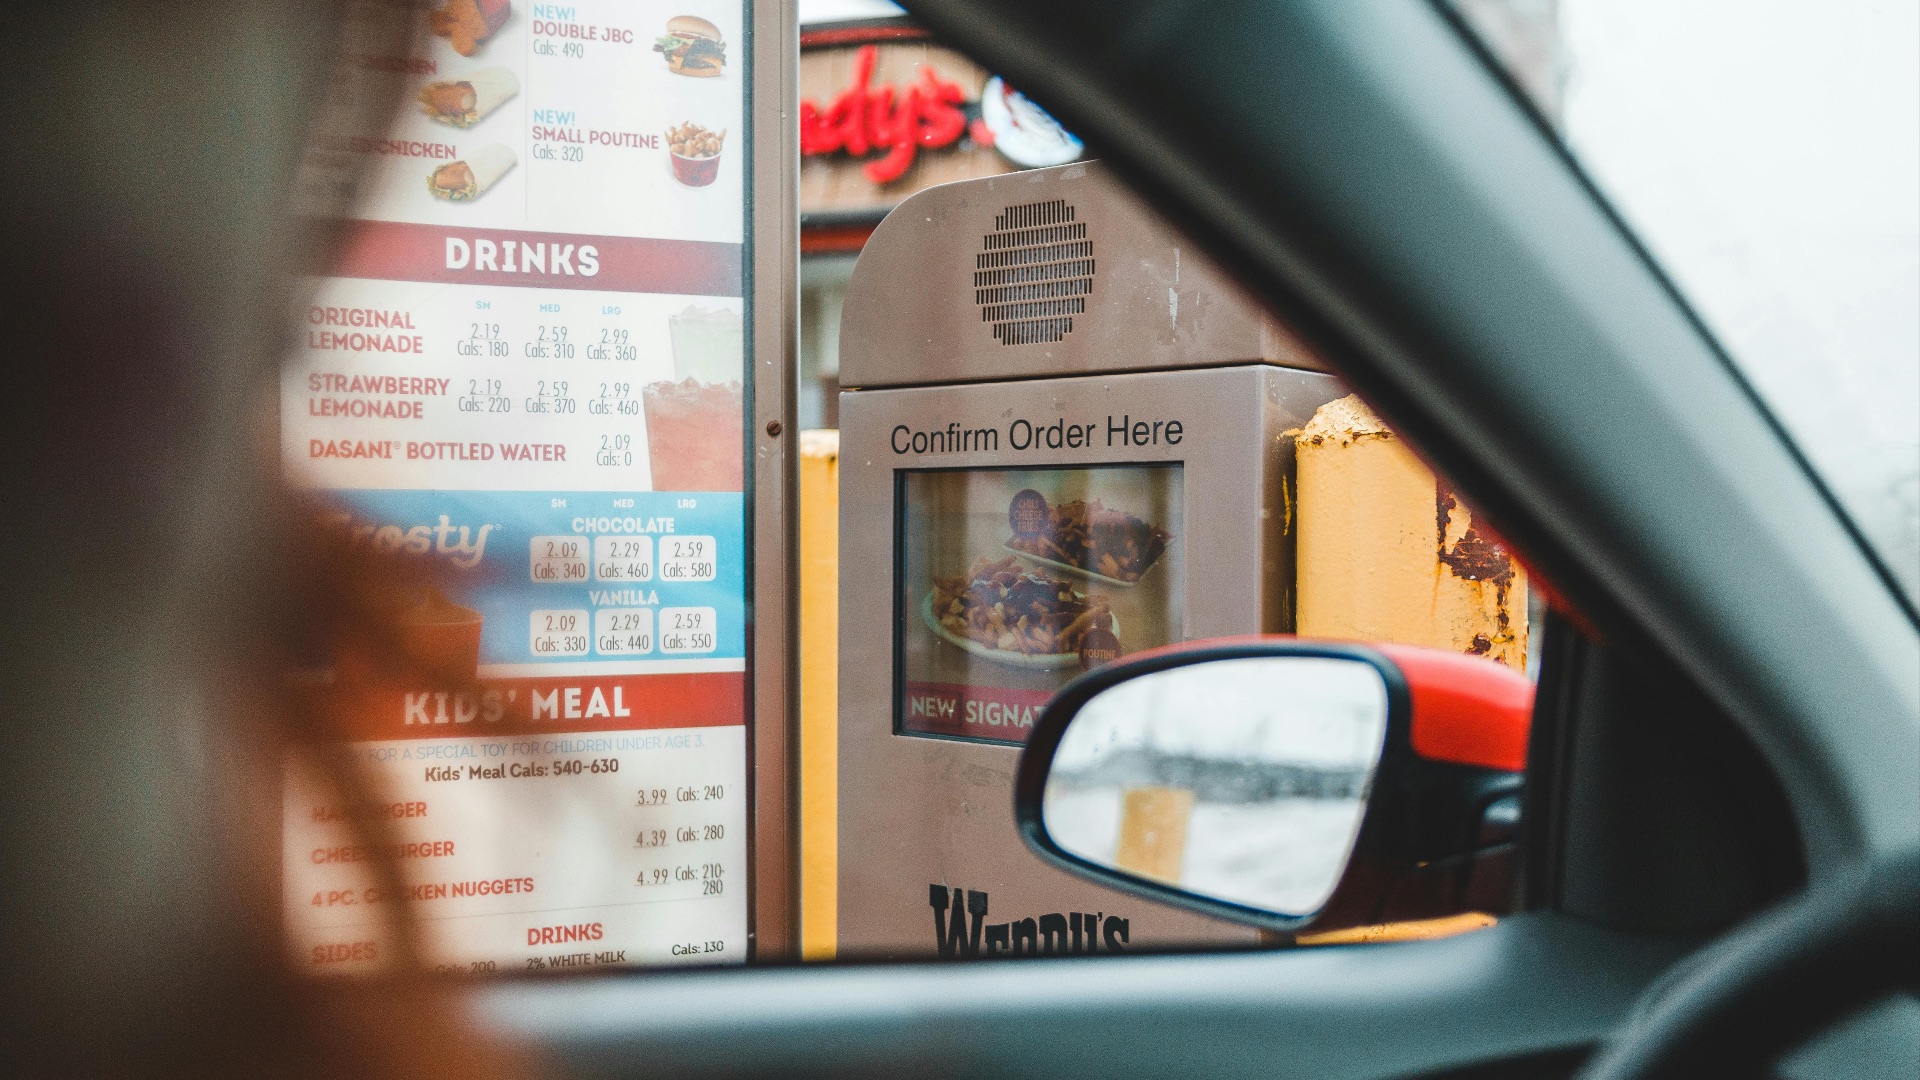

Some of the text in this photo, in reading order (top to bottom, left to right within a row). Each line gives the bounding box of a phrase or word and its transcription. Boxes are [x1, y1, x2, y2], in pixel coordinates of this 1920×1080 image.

[534, 4, 576, 21] NEW!
[533, 20, 633, 44] DOUBLE JBC
[533, 39, 584, 58] Cals: 490
[533, 109, 576, 126] NEW!
[532, 126, 660, 150] SMALL POUTINE
[533, 143, 584, 162] Cals: 320
[446, 237, 600, 277] DRINKS
[308, 305, 416, 330] ORIGINAL
[475, 301, 622, 316] SM MED LRG
[308, 331, 423, 355] LEMONADE
[471, 323, 629, 345] 2.19 2.59 2.99
[456, 339, 637, 362] Cals: 180 Cals: 310 Cals: 360
[308, 372, 450, 397] STRAWBERRY
[469, 379, 630, 399] 2.19 2.59 2.99
[308, 398, 423, 420] LEMONADE
[458, 397, 639, 417] Cals: 220 Cals: 370 Cals: 460
[601, 434, 631, 451] 2.09
[891, 415, 1184, 455] Confirm Order Here
[406, 442, 495, 462] BOTTLED
[499, 443, 567, 463] WATER
[596, 450, 632, 467] Cals: 0
[551, 498, 697, 510] SM MED LRG
[572, 517, 675, 534] CHOCOLATE
[546, 541, 704, 558] 2.09 2.29 2.59
[534, 561, 712, 580] Cals: 340 Cals: 460 Cals: 580
[589, 590, 660, 606] VANILLA
[545, 613, 702, 632] 2.09 2.29 2.59
[535, 632, 712, 653] Cals: 330 Cals: 440 Cals: 550
[1083, 648, 1116, 660] POUTINE
[532, 686, 631, 720] MEAL
[910, 696, 957, 719] NEW
[403, 747, 412, 759] A
[416, 745, 478, 760] SPECIAL
[481, 743, 507, 758] TOY
[512, 740, 540, 755] FOR
[543, 738, 612, 754] CHILDREN
[616, 736, 661, 751] UNDER
[665, 735, 691, 748] AGE
[425, 758, 619, 782] Kids' Meal Cals: 540-630
[638, 784, 724, 805] 3.99 Cals: 240
[636, 824, 724, 847] 4.39 Cals: 280
[637, 868, 668, 886] 4.99
[675, 865, 699, 882] Cals:
[311, 891, 323, 907] 4
[451, 877, 535, 898] NUGGETS
[703, 879, 723, 895] 280
[527, 922, 604, 946] DRINKS
[311, 942, 377, 965] SIDES
[671, 940, 724, 956] Cals: 130
[470, 960, 496, 974] 200
[526, 950, 626, 971] 2% WHITE MILK
